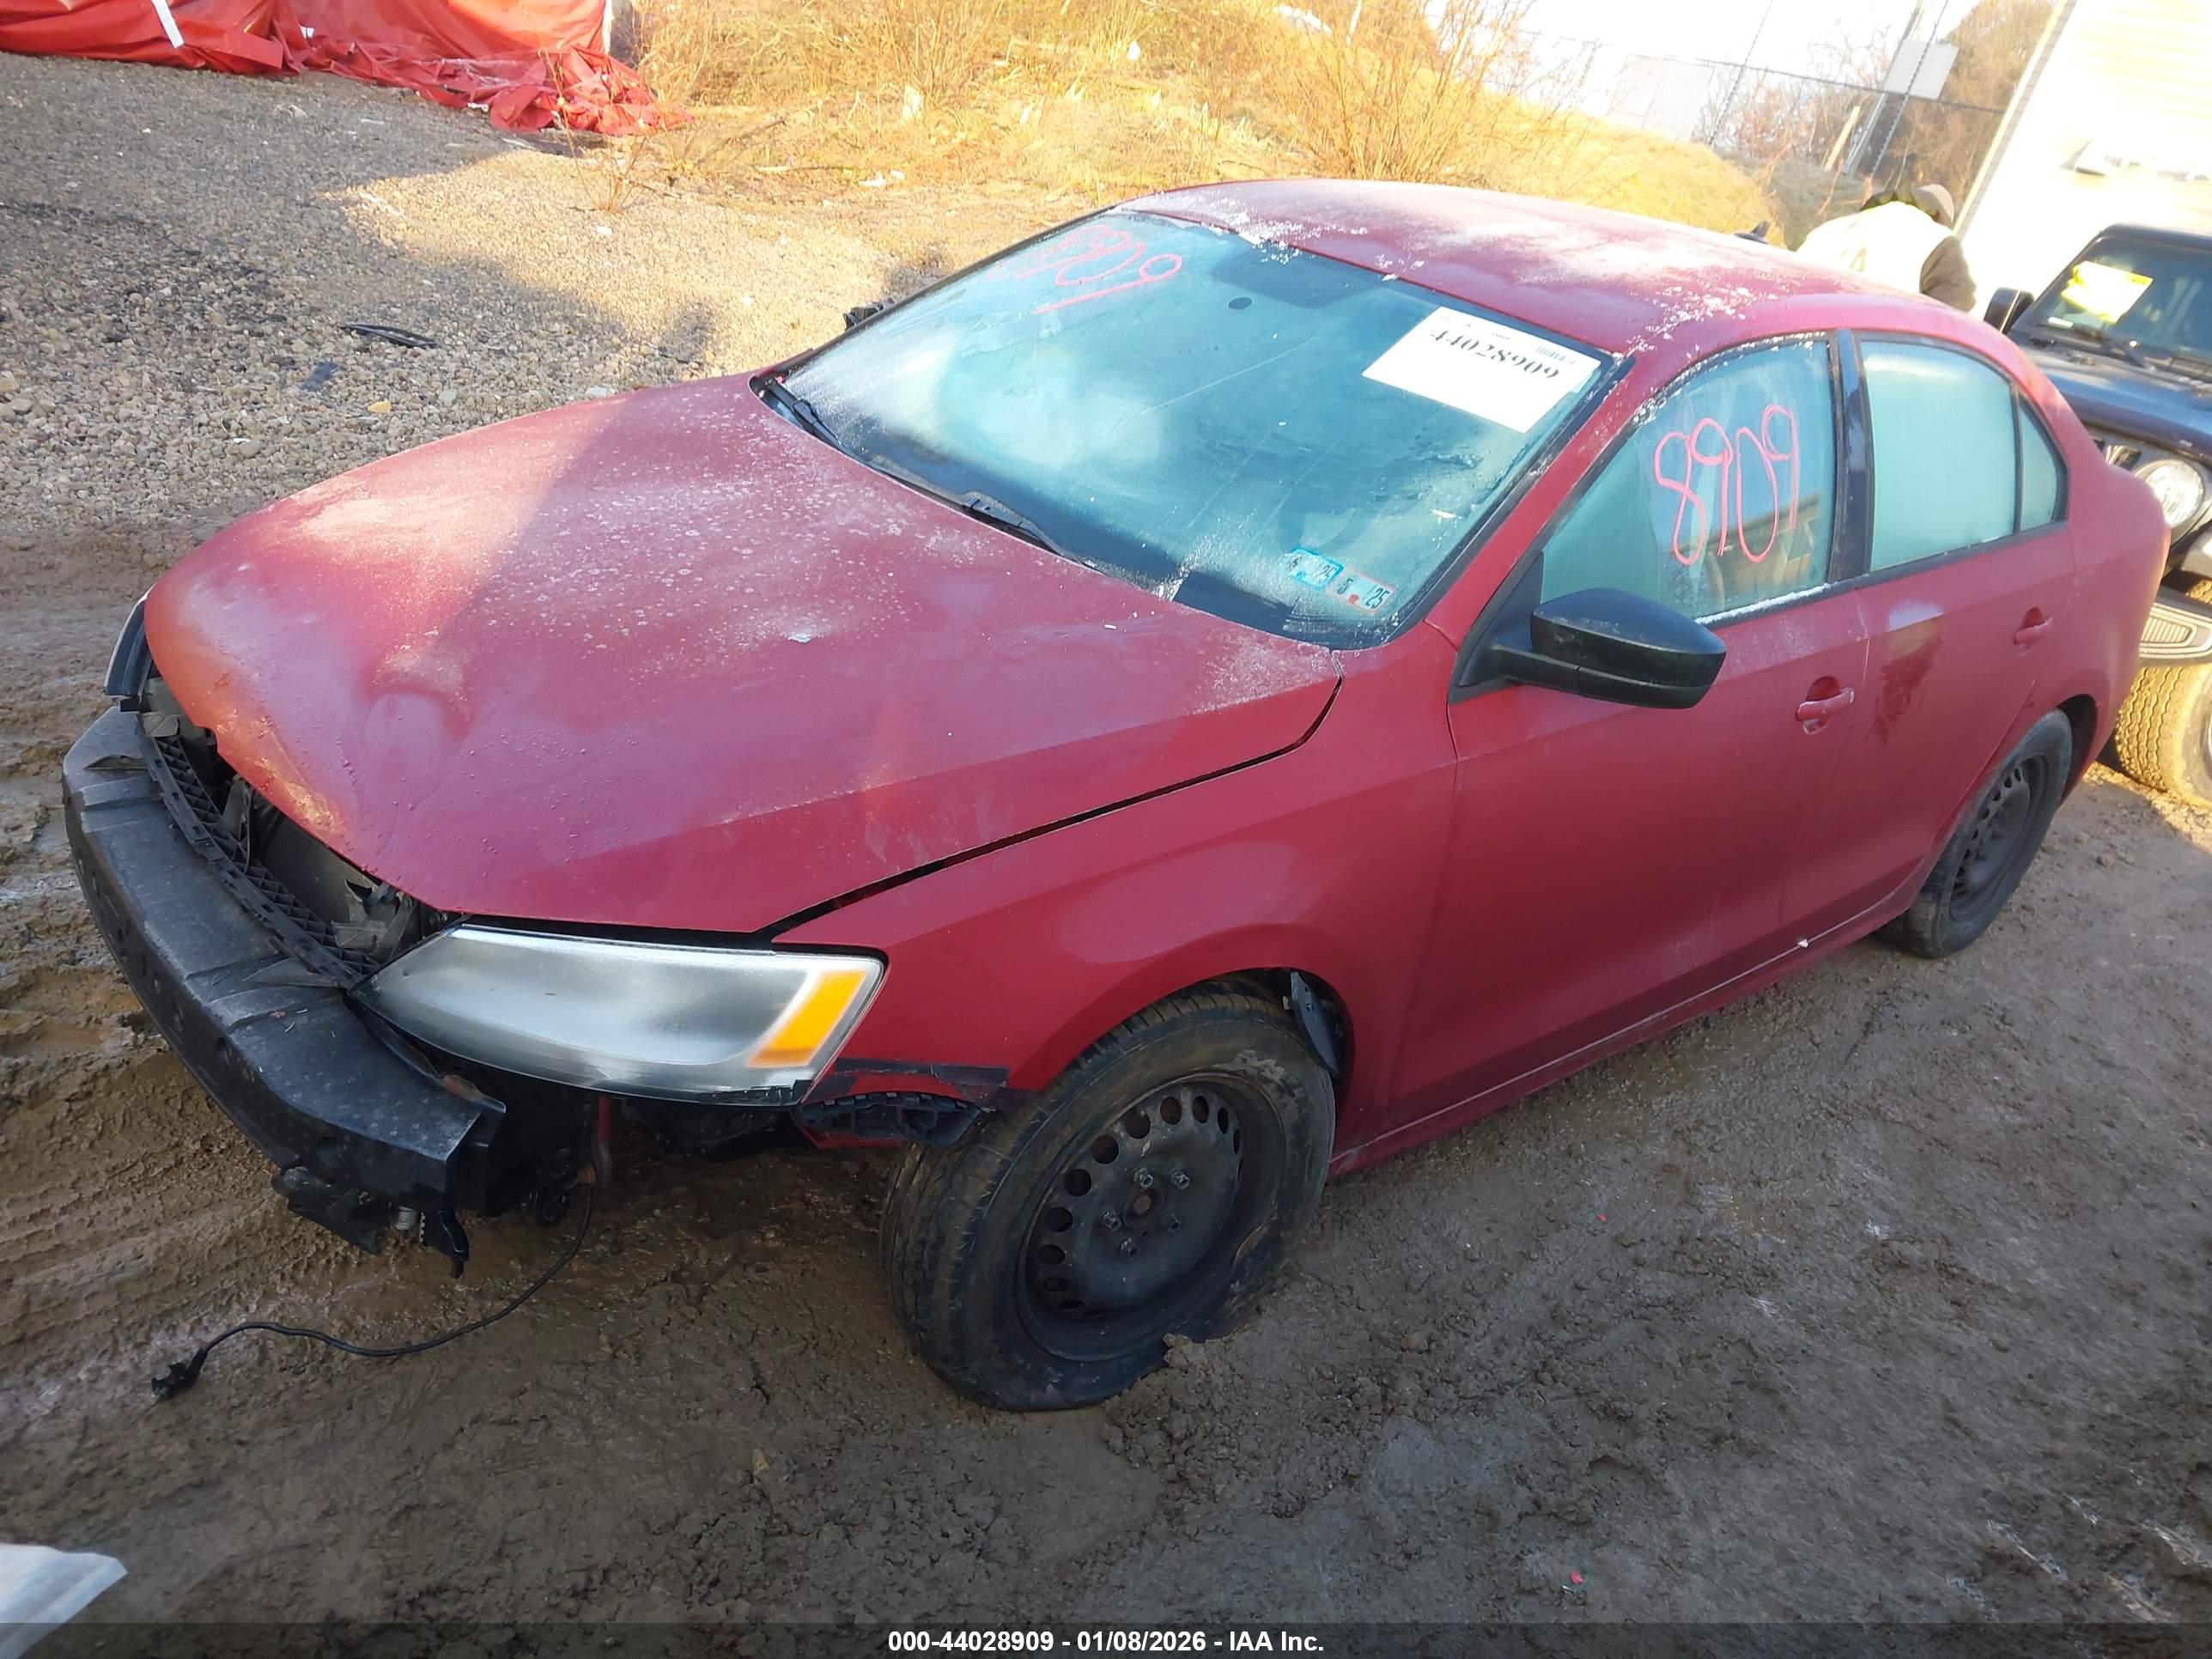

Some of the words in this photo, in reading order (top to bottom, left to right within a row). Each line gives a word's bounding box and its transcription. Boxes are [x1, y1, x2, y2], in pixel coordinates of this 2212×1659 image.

[1430, 329, 1560, 379] 44028909
[1654, 403, 1800, 566] 8909
[1337, 578, 1354, 595] 5
[1364, 587, 1390, 609] 25
